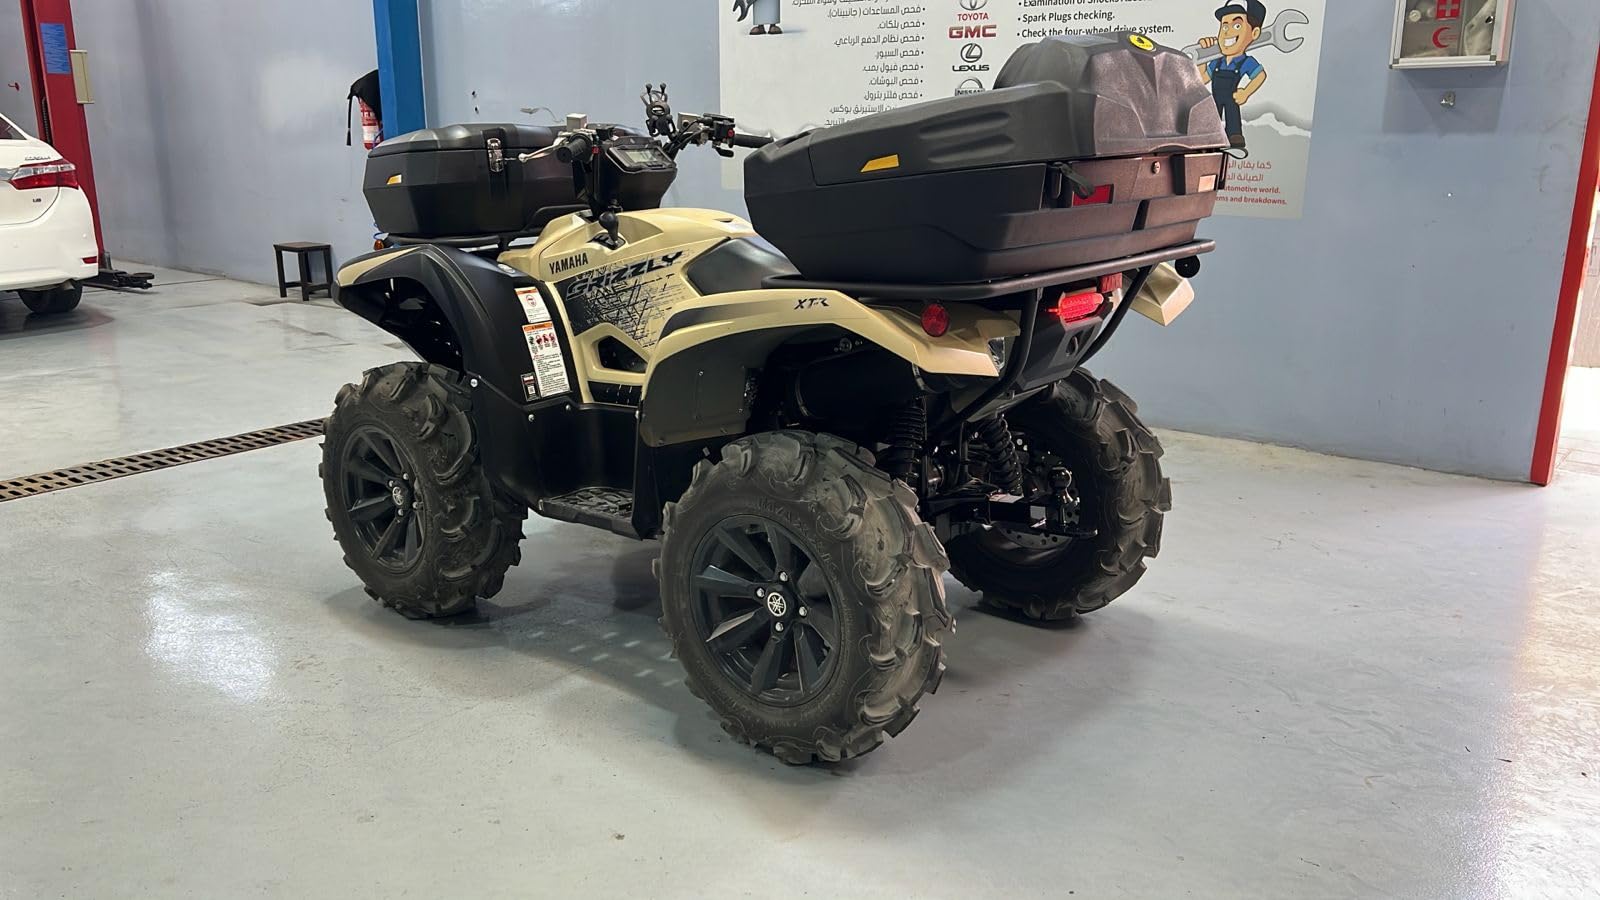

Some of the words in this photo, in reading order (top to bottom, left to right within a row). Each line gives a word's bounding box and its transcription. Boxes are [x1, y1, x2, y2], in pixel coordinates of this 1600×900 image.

[862, 5, 900, 16] المساعدات
[900, 5, 921, 15] فحص
[957, 12, 989, 21] TOYOTA
[1022, 13, 1047, 24] Spark
[1048, 12, 1072, 23] Plugs
[1073, 10, 1115, 22] checking.
[900, 19, 921, 29] فحص
[948, 24, 997, 39] GMC
[1021, 28, 1047, 38] Check
[1049, 27, 1063, 36] the
[1064, 25, 1112, 36] four-wheel
[1138, 24, 1174, 36] system.
[861, 34, 880, 46] الدفع
[881, 34, 898, 45] نظام
[900, 33, 920, 44] فحص
[900, 48, 920, 58] فحص
[899, 62, 920, 72] فحص
[952, 64, 990, 72] LEXUS
[899, 76, 919, 86] فحص
[898, 90, 918, 101] فحص
[1224, 185, 1258, 193] utomotive
[1259, 186, 1281, 194] world.
[1244, 196, 1288, 205] breakdowns.
[549, 252, 589, 275] YAMAHA
[565, 250, 684, 301] GRIZZLY
